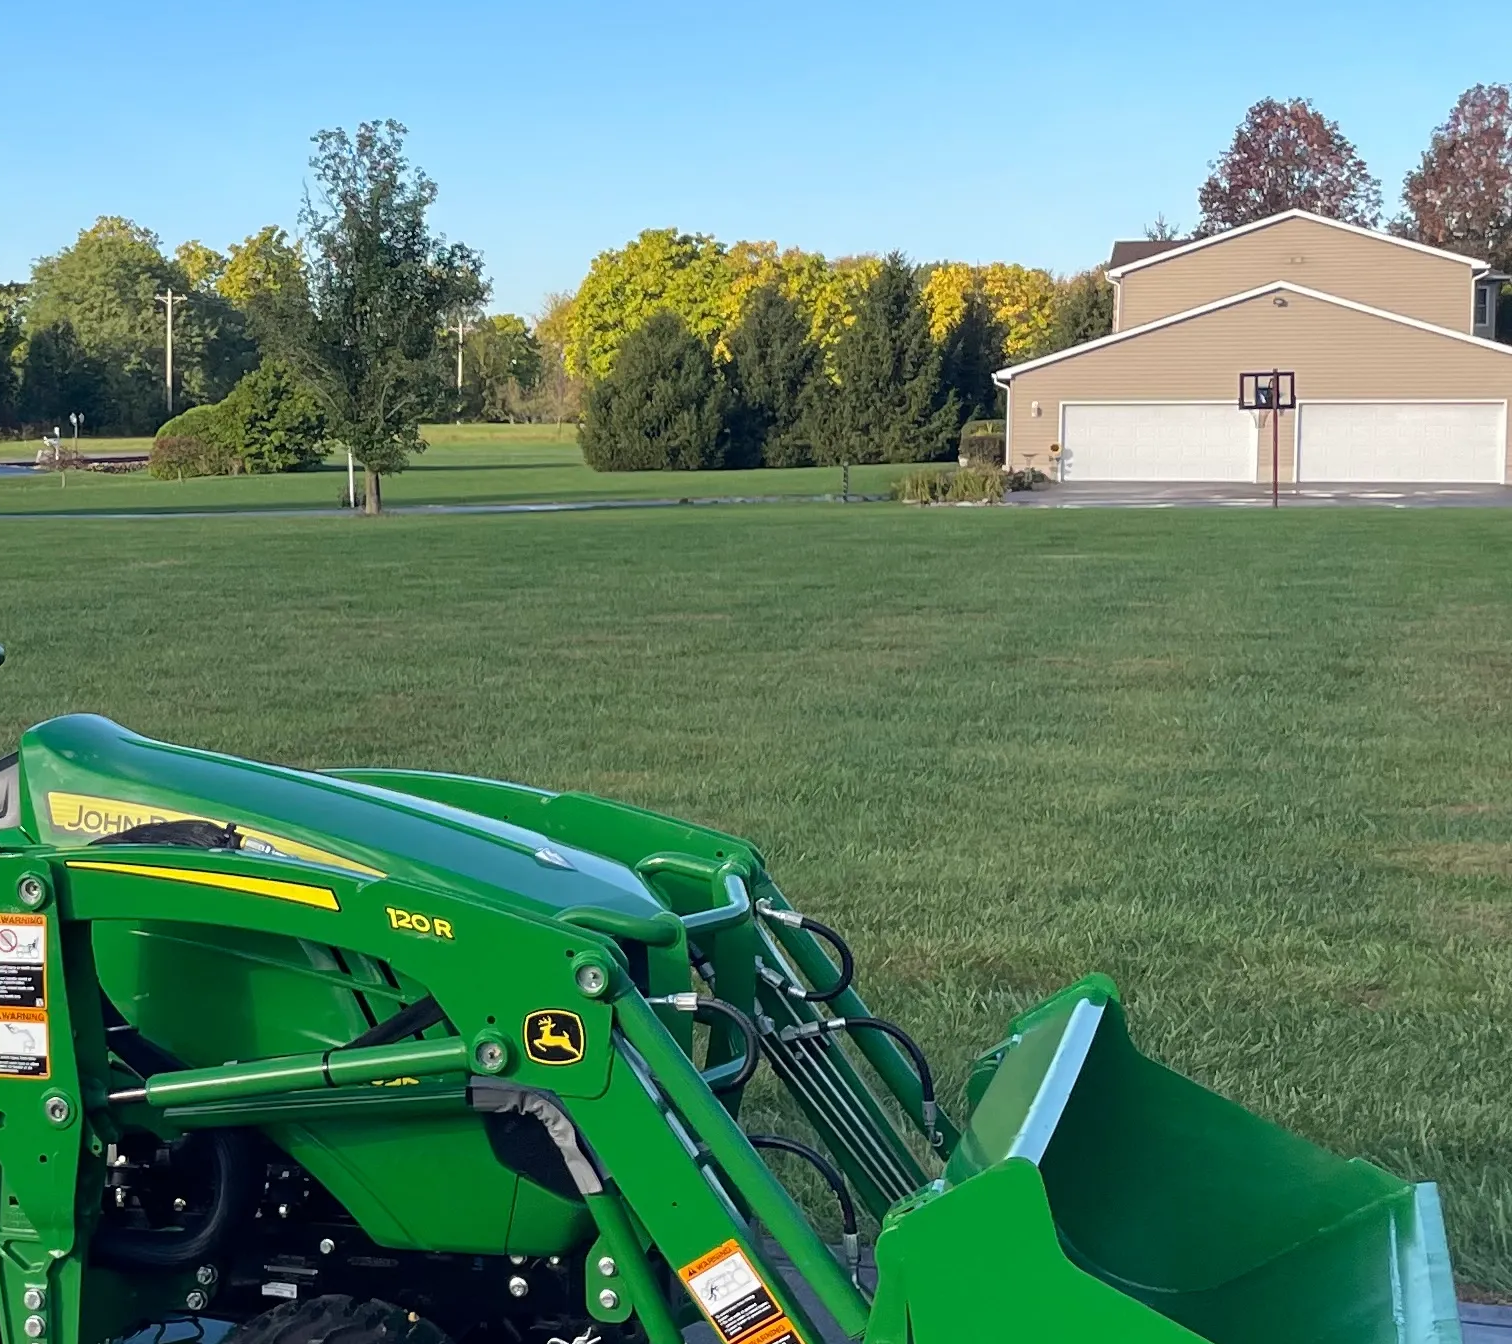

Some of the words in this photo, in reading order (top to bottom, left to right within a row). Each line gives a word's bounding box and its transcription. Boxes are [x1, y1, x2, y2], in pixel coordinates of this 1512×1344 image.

[1, 916, 43, 925] WARNING
[2, 1012, 45, 1022] WARNING
[696, 1246, 733, 1272] WARNING
